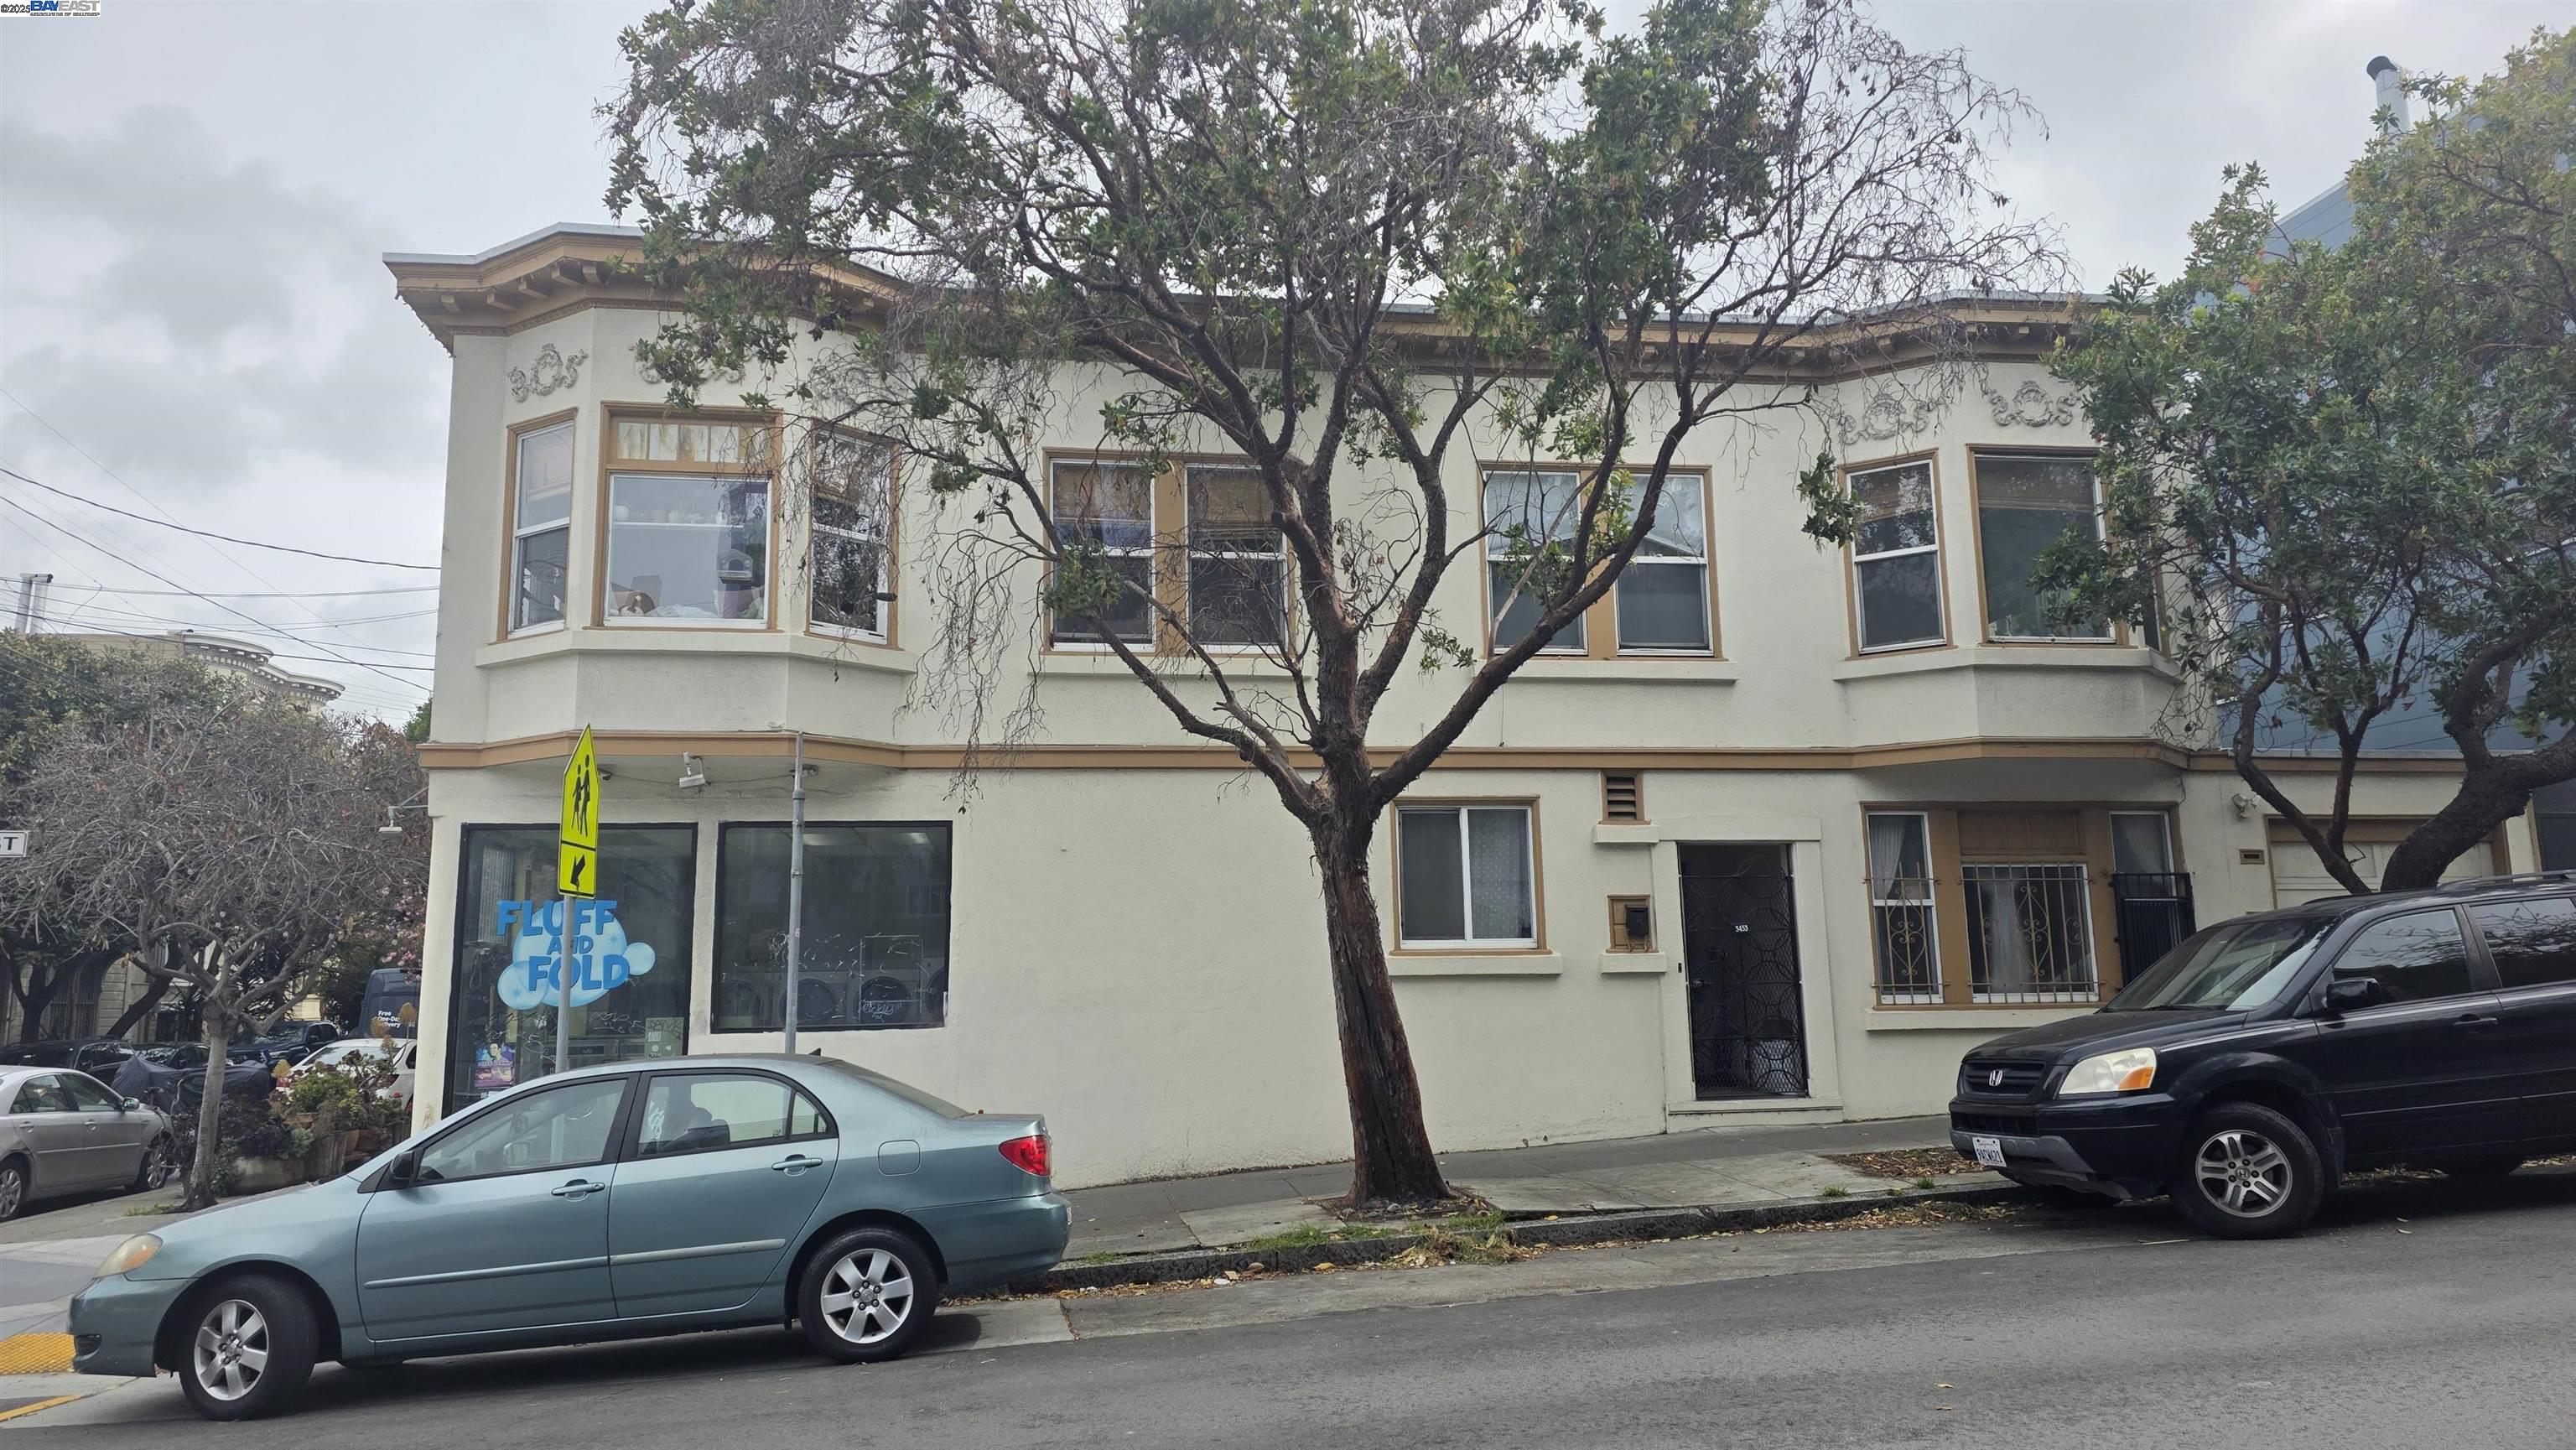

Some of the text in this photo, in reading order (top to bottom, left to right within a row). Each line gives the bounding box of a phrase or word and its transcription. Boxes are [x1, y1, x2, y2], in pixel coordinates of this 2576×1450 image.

[0, 837, 18, 850] T
[496, 900, 617, 936] FLUFF
[528, 954, 630, 991] FOLD
